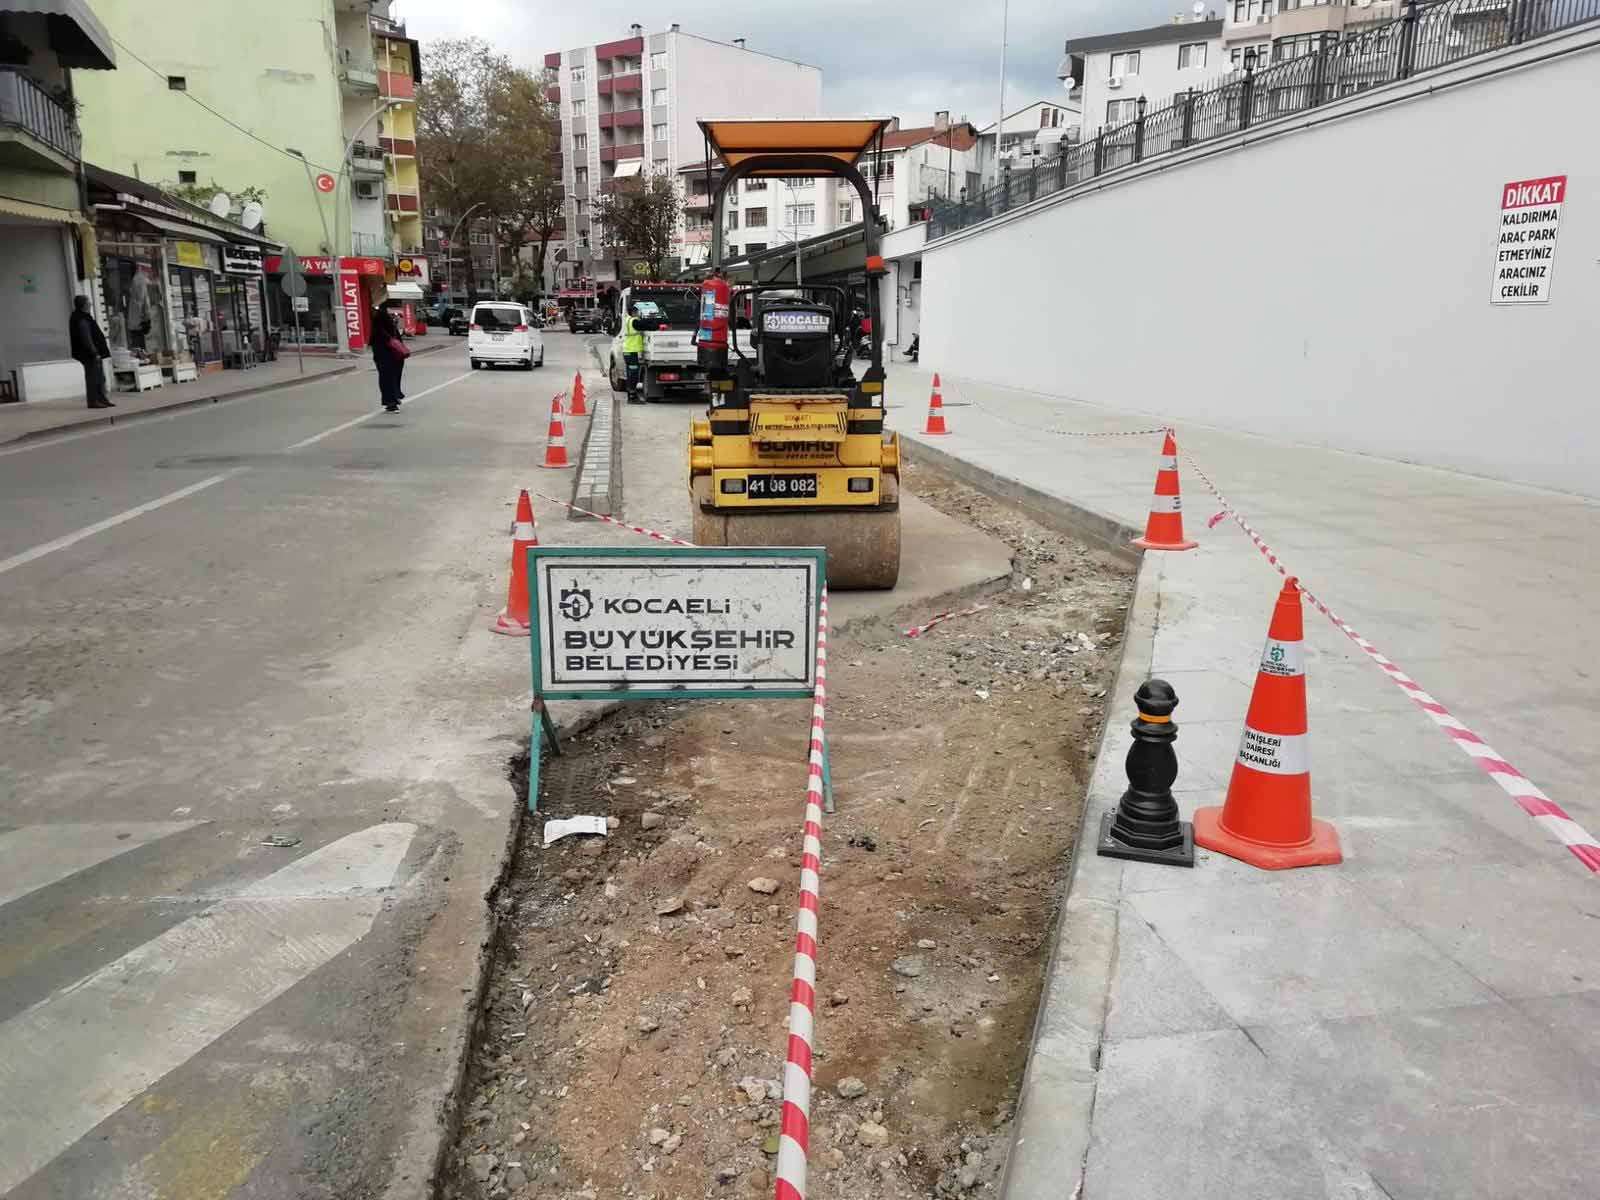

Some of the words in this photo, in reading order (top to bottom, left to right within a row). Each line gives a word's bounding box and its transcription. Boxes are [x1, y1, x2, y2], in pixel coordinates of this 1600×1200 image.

[1506, 182, 1561, 207] DİKKAT
[1502, 209, 1557, 226] KALDIRIMA
[1500, 231, 1526, 244] ARAÇ
[1528, 228, 1556, 241] PARK
[1499, 245, 1553, 262] ETMEYİNİZ
[1499, 266, 1546, 280] ARACINIZ
[1501, 282, 1539, 298] ÇEKİLİR
[749, 479, 765, 492] 41
[770, 479, 786, 492] 08
[790, 479, 815, 492] 082
[564, 630, 794, 651] BÜYÜKŞEHİR
[566, 655, 738, 671] BELEDİYESİ
[1246, 742, 1275, 756] DAİRESİ
[1240, 750, 1281, 768] BAŞKANLIĞI
